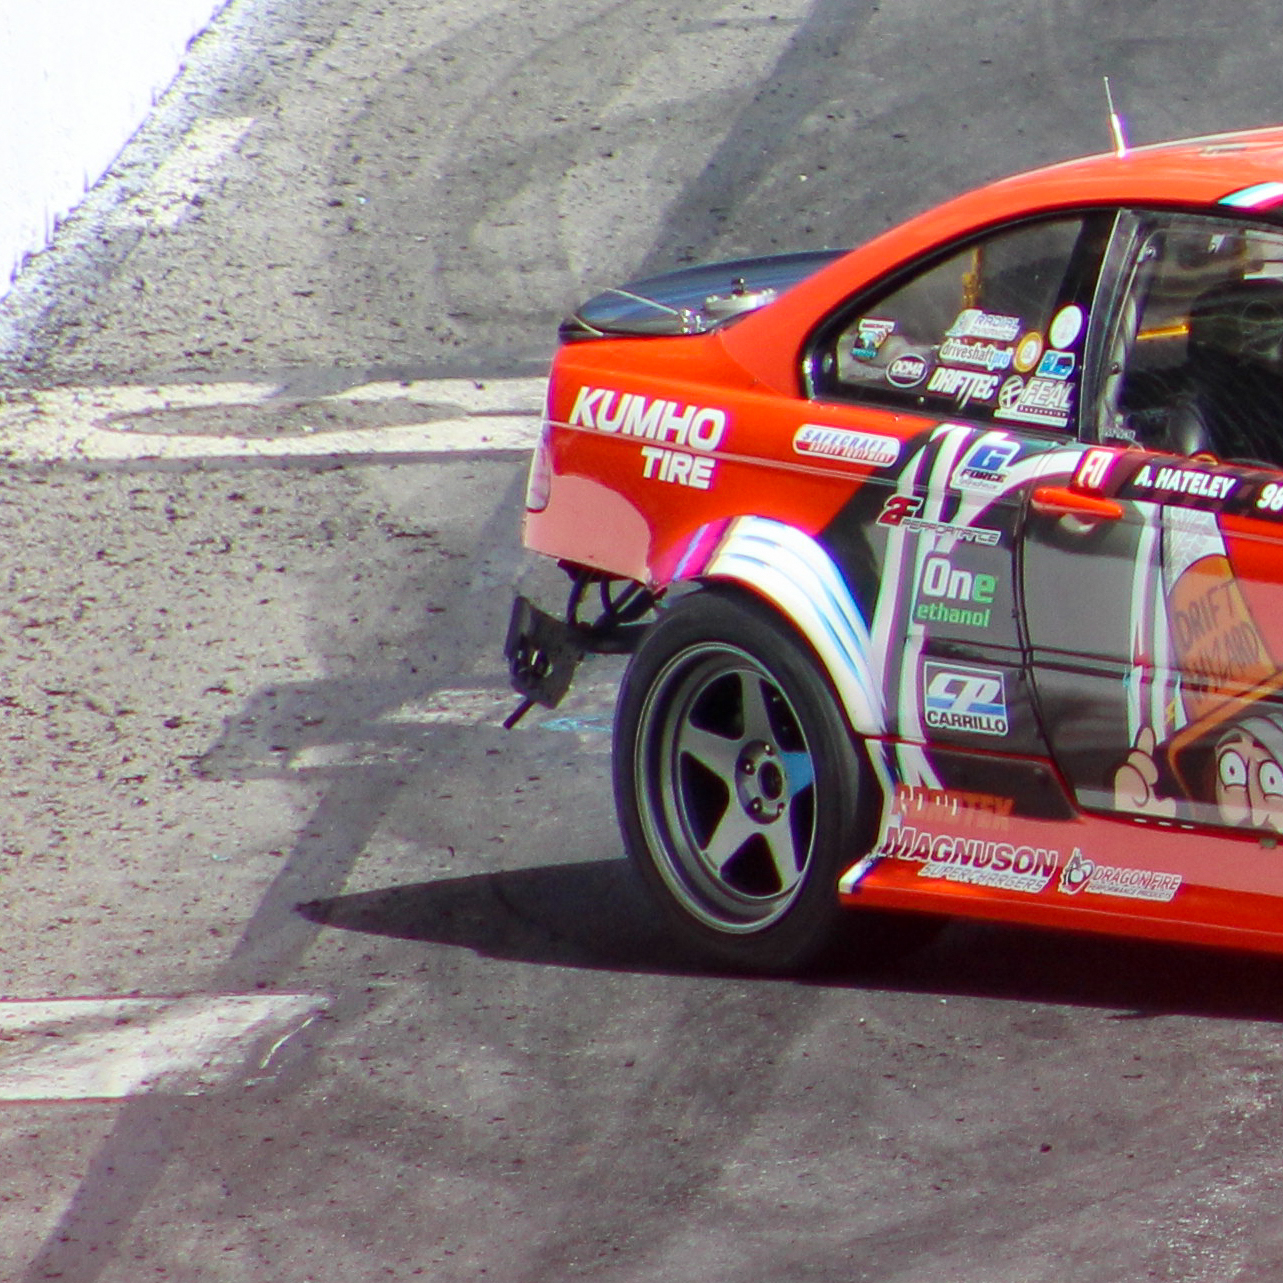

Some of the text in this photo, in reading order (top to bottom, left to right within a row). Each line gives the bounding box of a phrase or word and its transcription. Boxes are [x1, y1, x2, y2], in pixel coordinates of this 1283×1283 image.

[1021, 377, 1076, 409] FEAL
[569, 385, 726, 452] KUMHO
[802, 428, 889, 451] SAFECRAFT
[641, 445, 717, 491] TIRE
[961, 468, 1006, 484] FORCE
[1133, 464, 1237, 500] A. HATELEY
[921, 556, 997, 604] One
[916, 601, 991, 628] ethanol
[927, 672, 1001, 712] CP
[926, 710, 1007, 733] CARRILLO
[879, 826, 1058, 879] MAGNUSON
[920, 862, 1048, 892] SUPERCHARGERS
